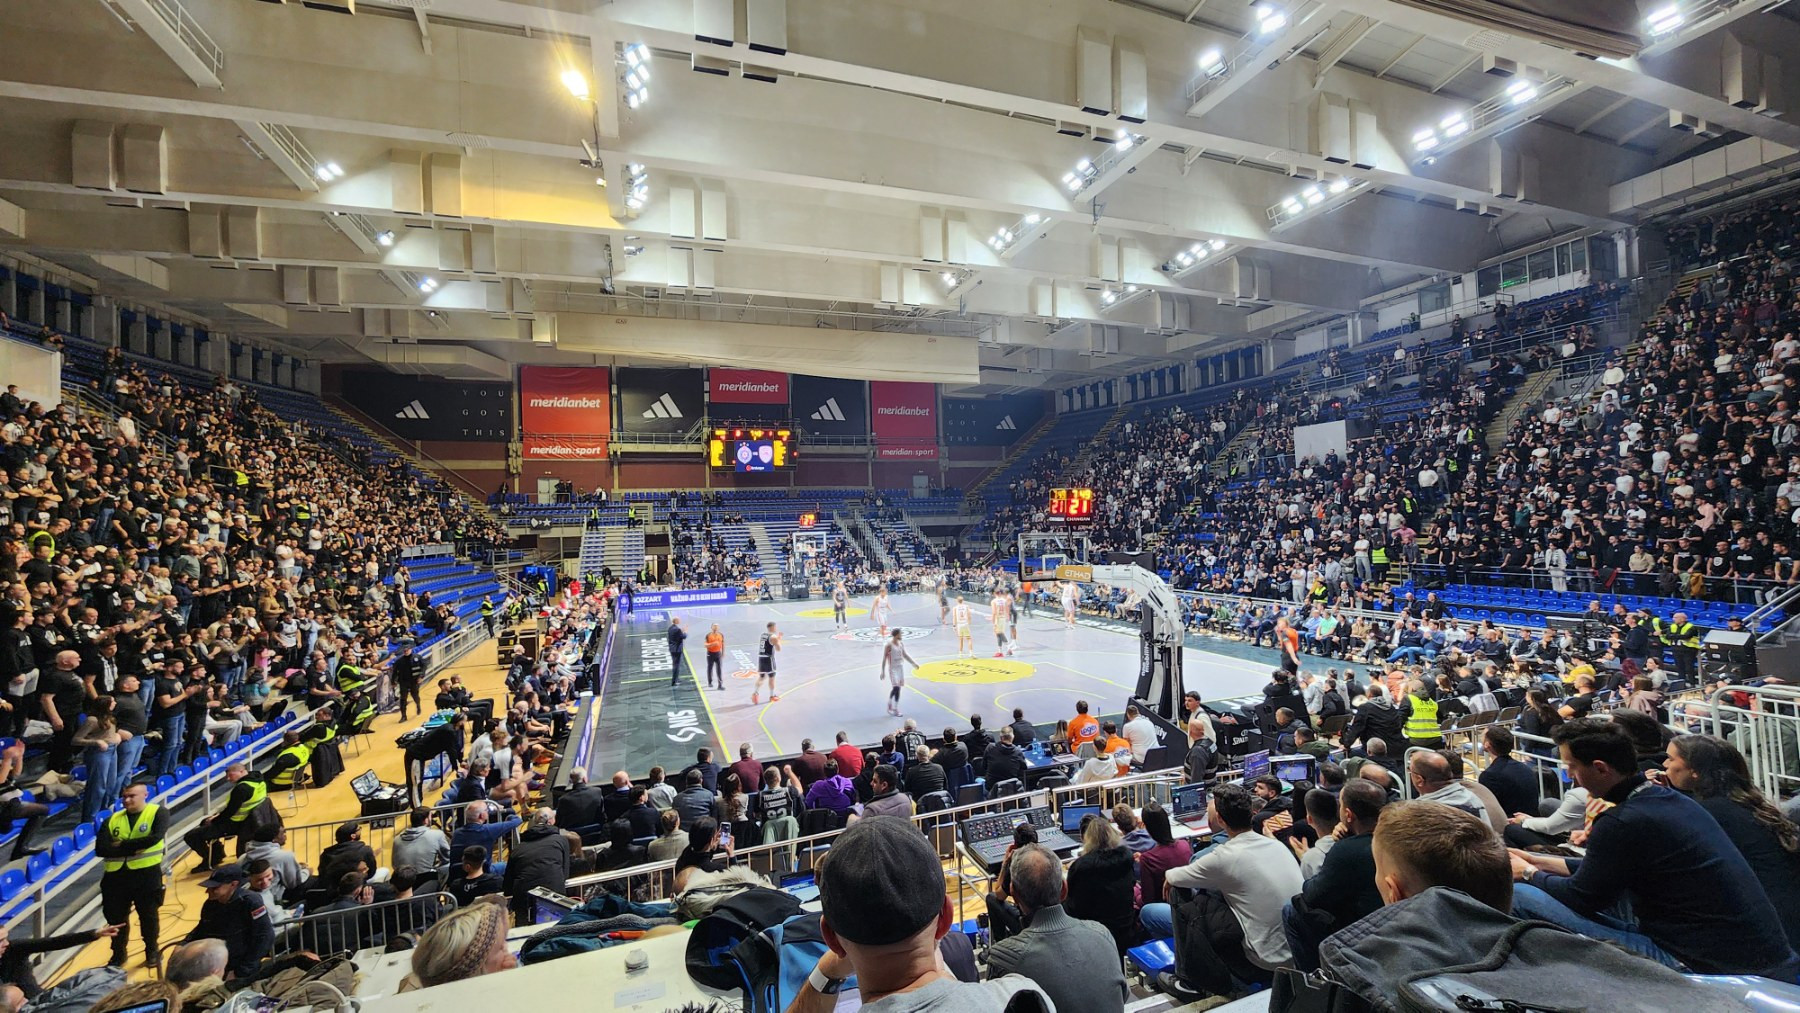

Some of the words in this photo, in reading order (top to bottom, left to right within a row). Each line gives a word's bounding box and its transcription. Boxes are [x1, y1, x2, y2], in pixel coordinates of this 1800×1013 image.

[719, 382, 779, 392] meridianbet
[462, 389, 504, 397] YOU
[530, 396, 600, 408] meridianbet
[462, 409, 504, 417] GOT
[877, 406, 930, 416] meridianbet
[462, 429, 505, 437] THIS
[1069, 499, 1088, 514] 21
[1064, 570, 1091, 579] ETIHAD
[112, 826, 120, 838] 6
